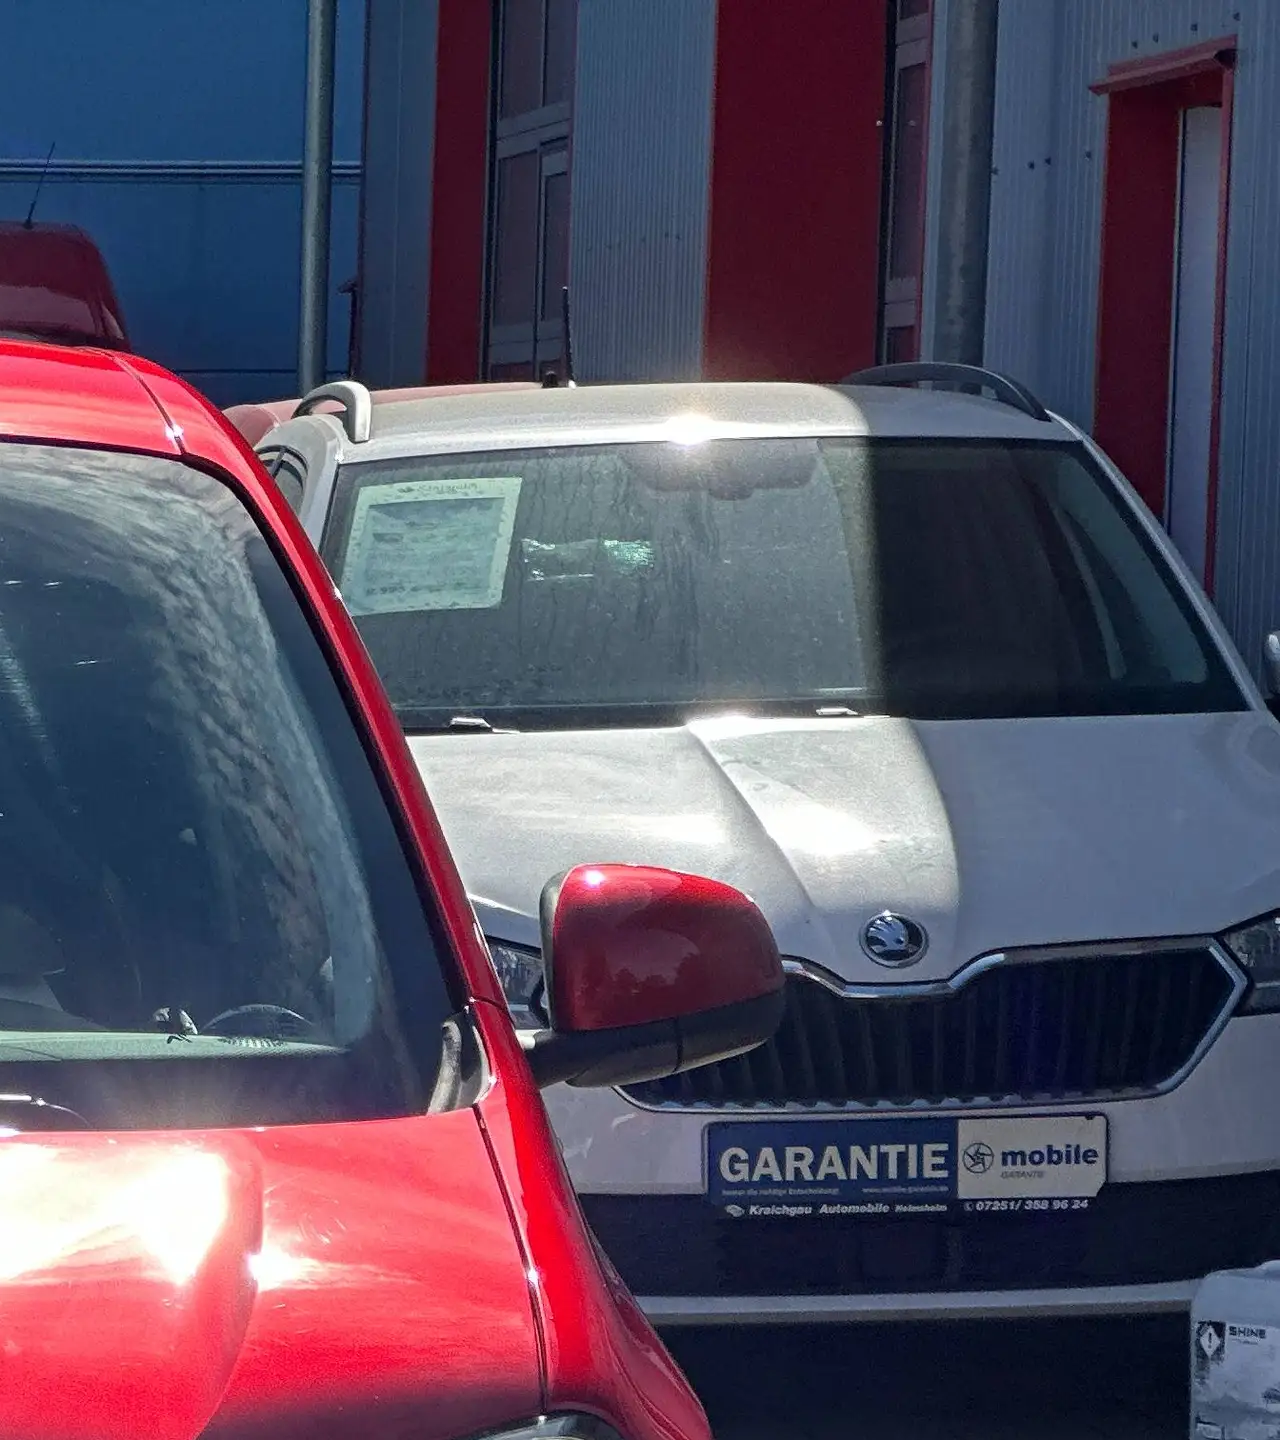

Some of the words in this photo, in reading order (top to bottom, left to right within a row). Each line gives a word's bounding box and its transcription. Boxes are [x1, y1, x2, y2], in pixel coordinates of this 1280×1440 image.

[1000, 1143, 1100, 1167] mobile
[719, 1144, 950, 1183] GARANTIE
[748, 1203, 813, 1218] Kraichgau
[819, 1202, 890, 1215] Automobile
[1072, 1200, 1089, 1210] 24
[1228, 1325, 1266, 1339] SHINE
